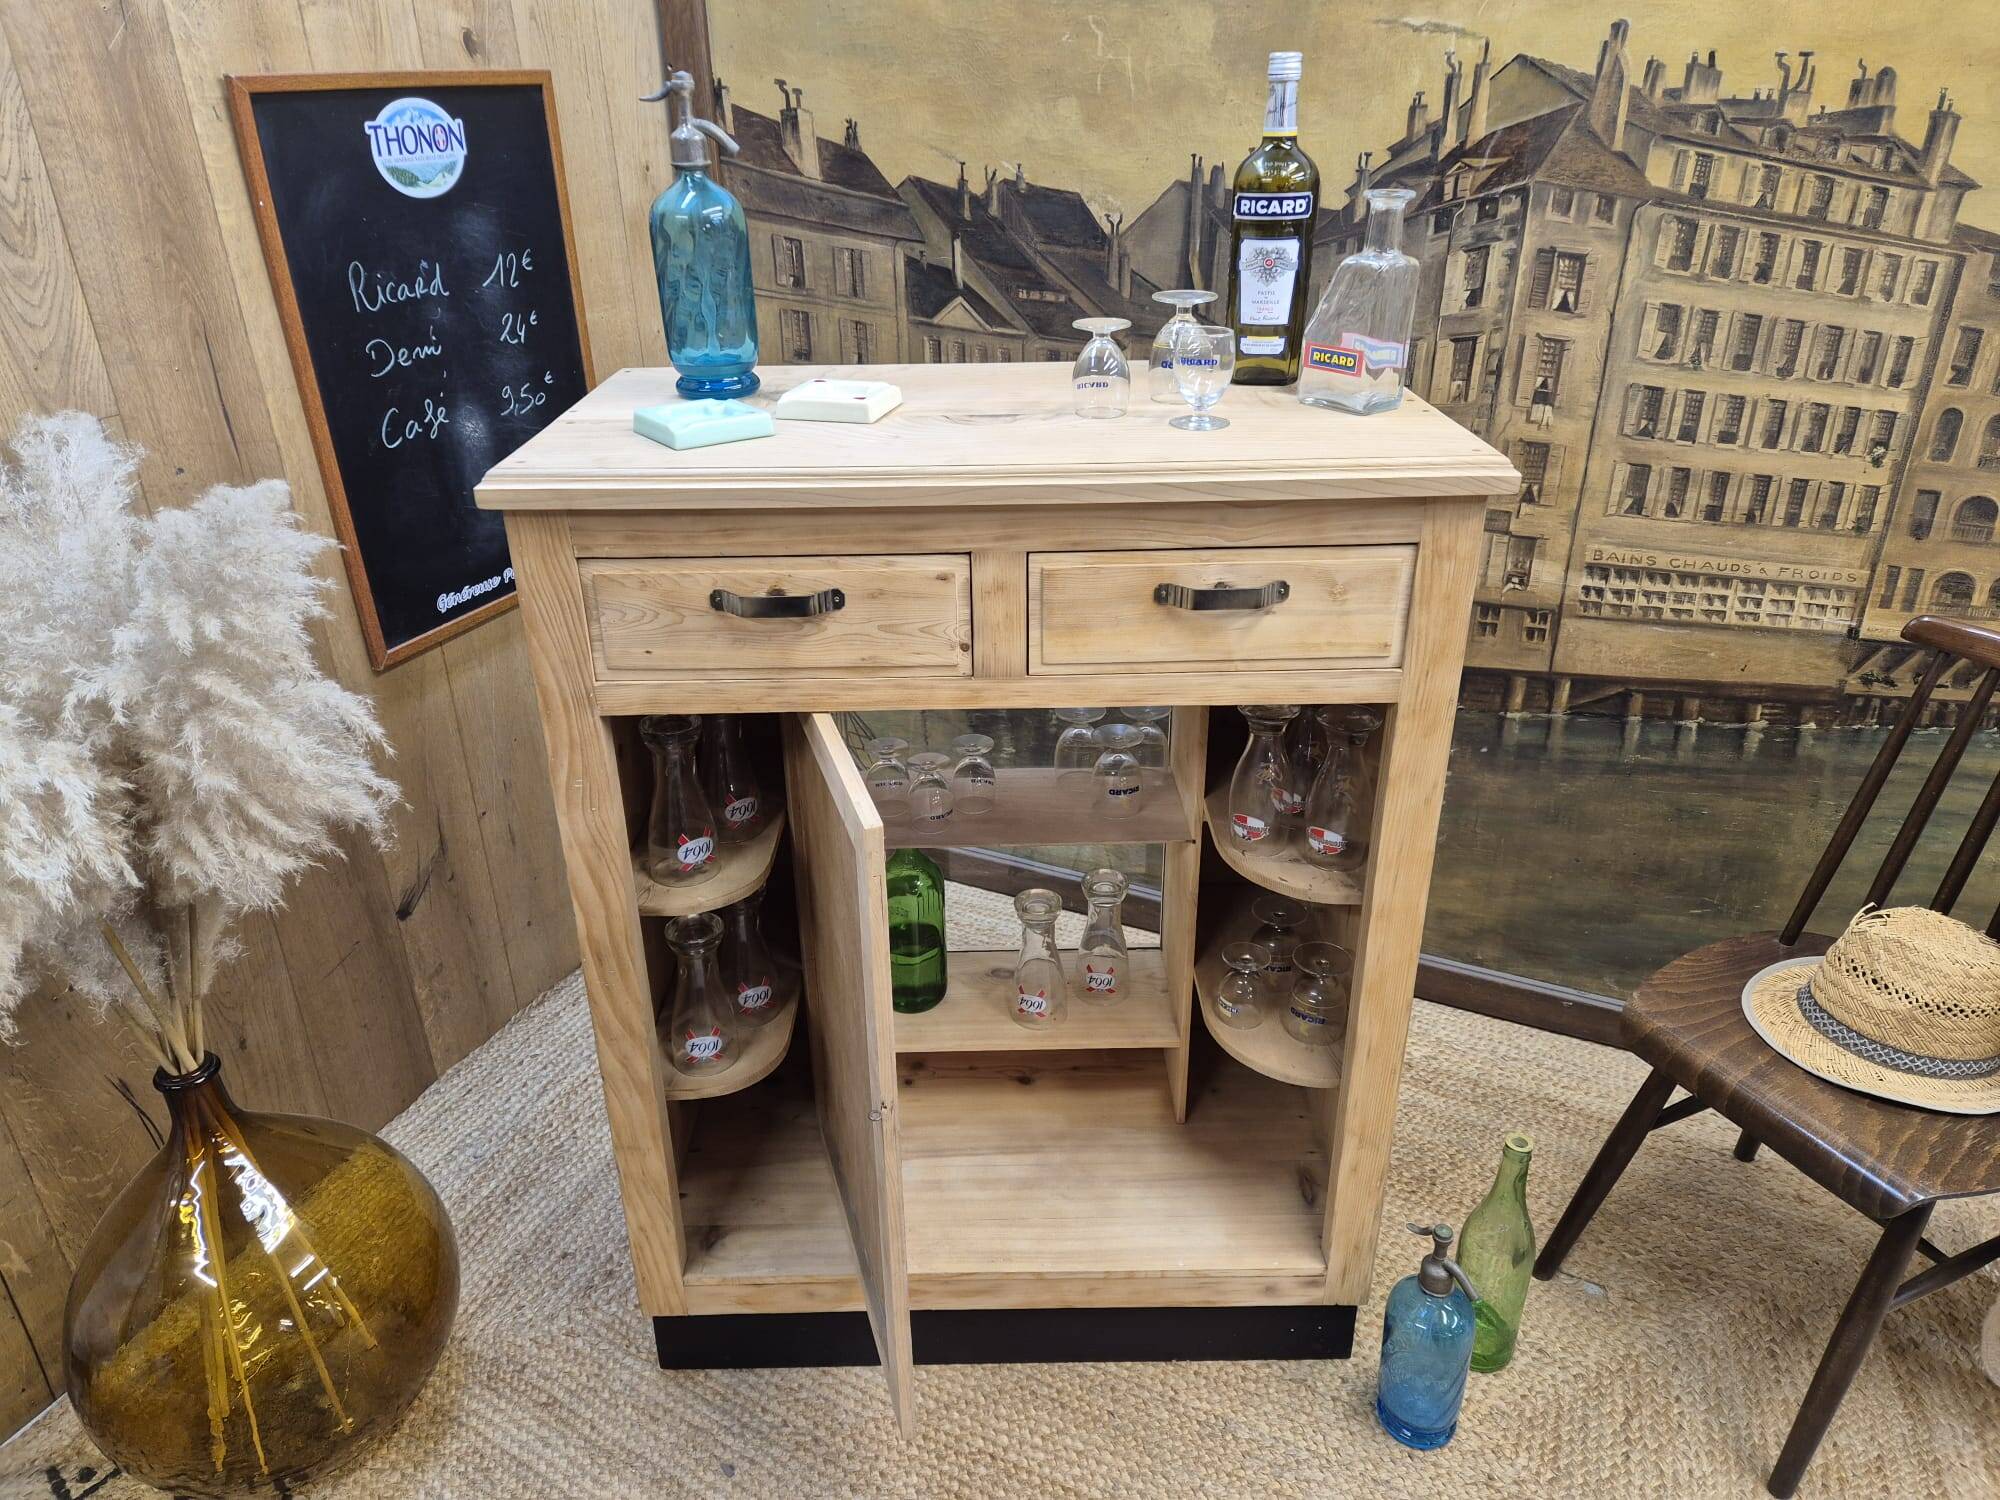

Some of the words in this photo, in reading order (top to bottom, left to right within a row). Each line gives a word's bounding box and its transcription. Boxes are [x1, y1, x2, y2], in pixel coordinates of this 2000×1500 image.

[368, 123, 464, 157] THONON
[1240, 198, 1306, 214] RICARD
[349, 261, 449, 312] Ricard
[1313, 351, 1354, 367] RICARD
[382, 391, 449, 449] Café
[1592, 549, 1657, 567] BAINS
[1669, 558, 1752, 574] CHAUDS
[1776, 566, 1858, 584] FROIDS
[437, 576, 501, 614] Généreuse
[728, 799, 756, 819] 1664
[682, 839, 711, 861] 1664
[1087, 975, 1113, 988] 1664
[743, 989, 770, 1005] 1664
[1019, 996, 1043, 1010] 1664
[690, 1039, 719, 1053] 1664
